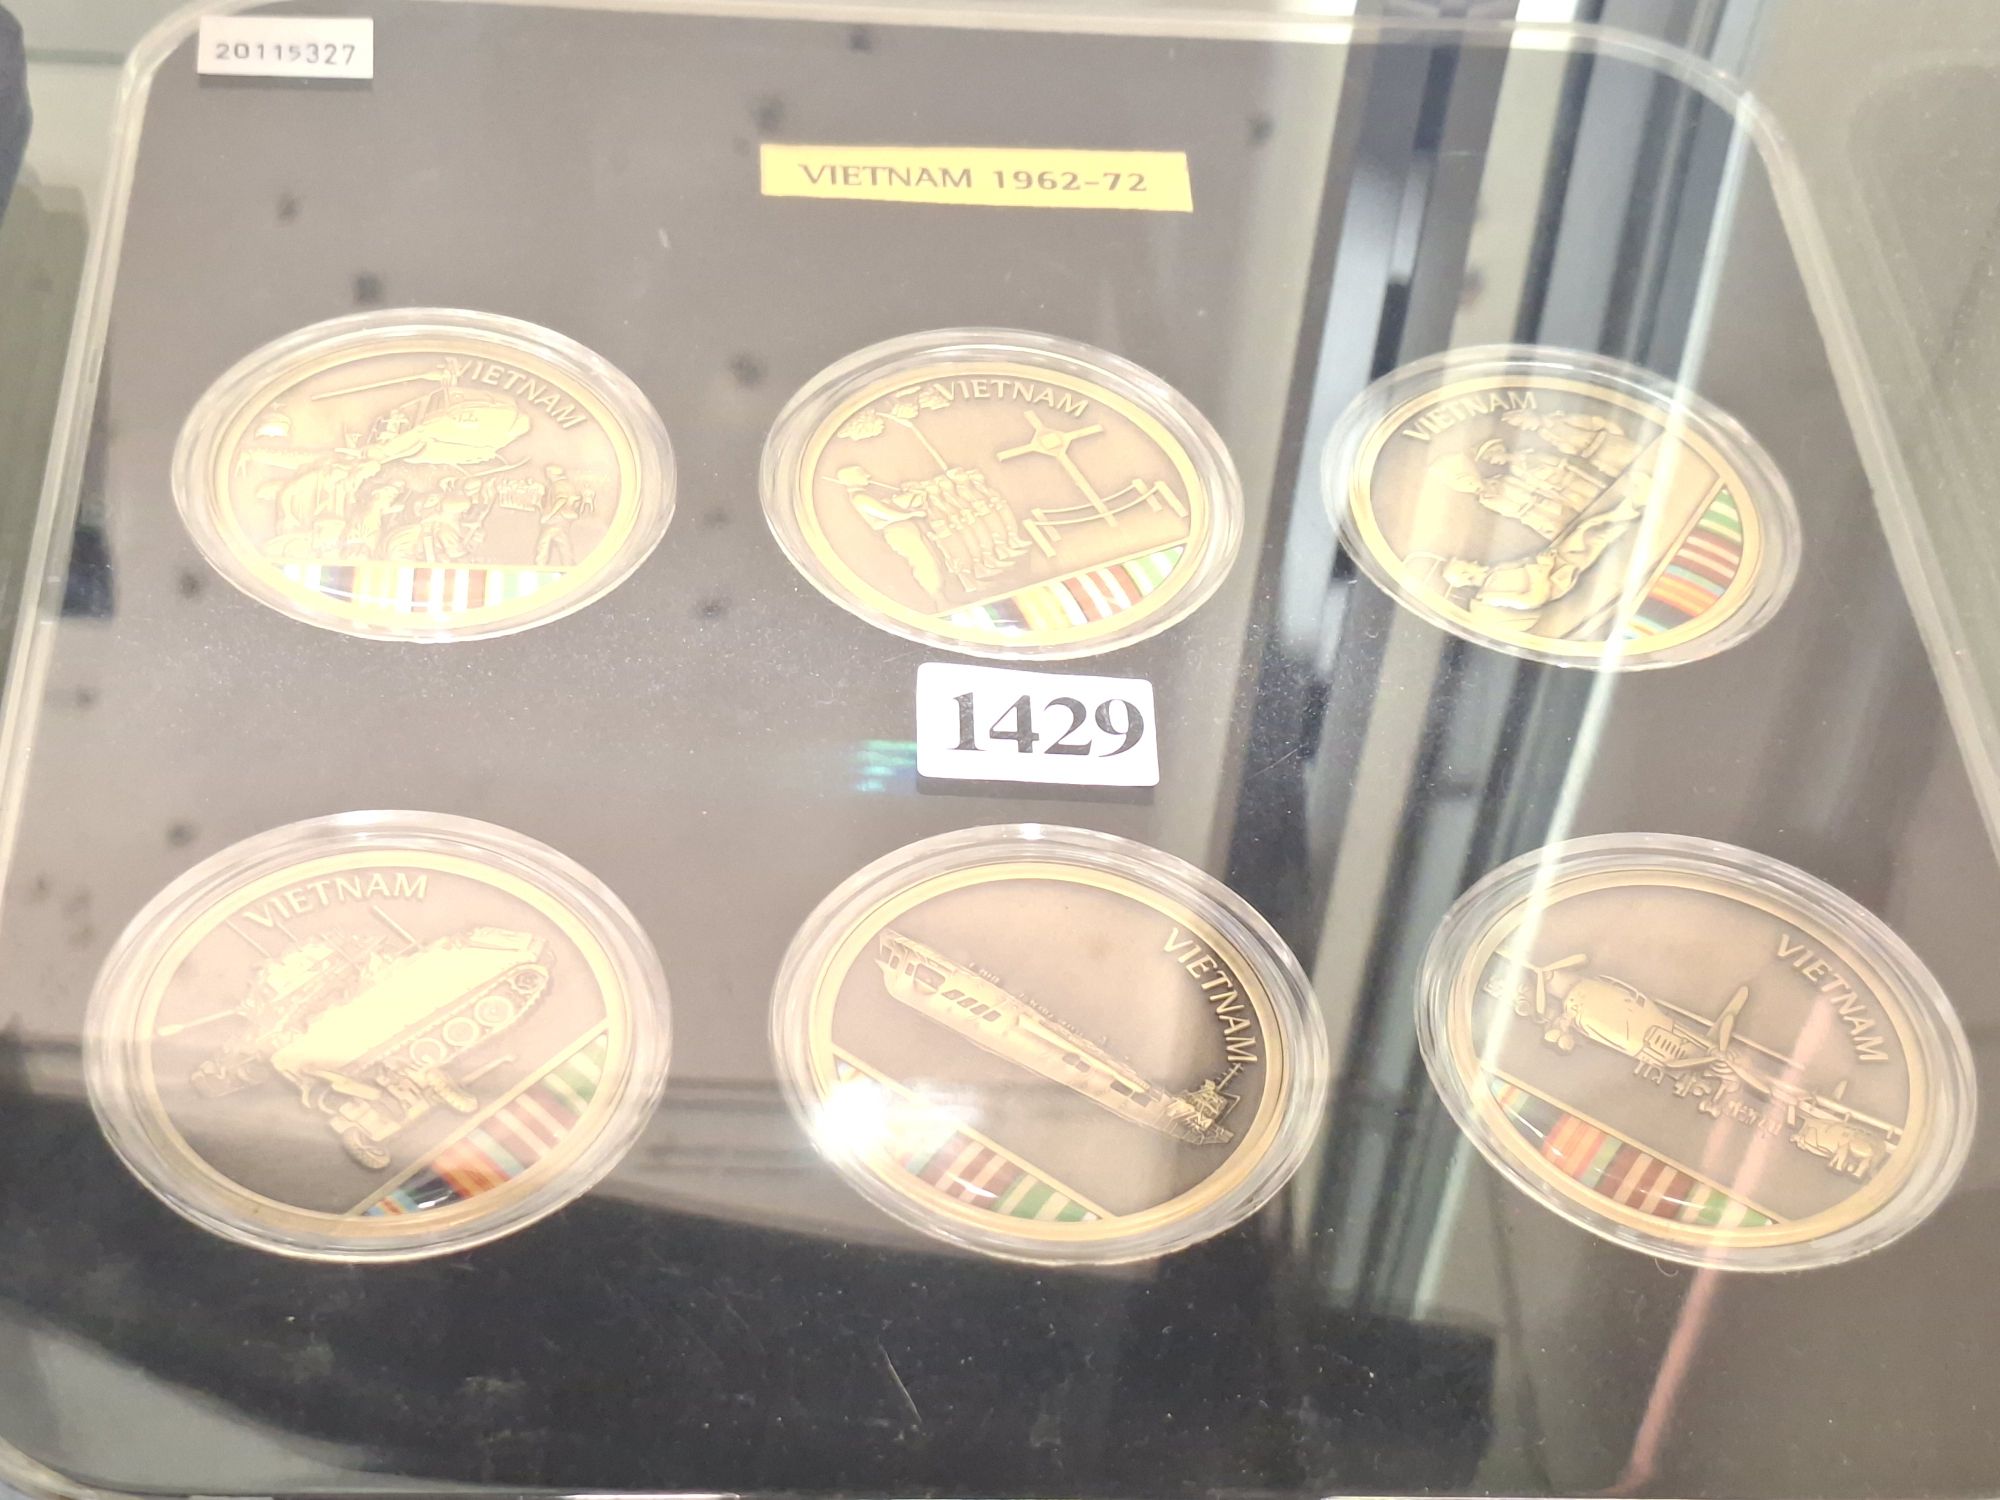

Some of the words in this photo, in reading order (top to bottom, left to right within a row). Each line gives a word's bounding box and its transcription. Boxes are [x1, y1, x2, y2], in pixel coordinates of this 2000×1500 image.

[215, 43, 356, 65] 20115327
[798, 163, 973, 188] VIETNAM
[993, 169, 1148, 192] 1962-72
[445, 356, 588, 430] VIETNAM
[933, 378, 1089, 417] VIETNAM
[1402, 390, 1538, 441] VIETNAM
[948, 692, 1145, 757] 1429
[242, 872, 428, 929] VIETNAM
[1163, 927, 1258, 1062] VIETNAM
[1777, 933, 1889, 1061] VIETNAM
